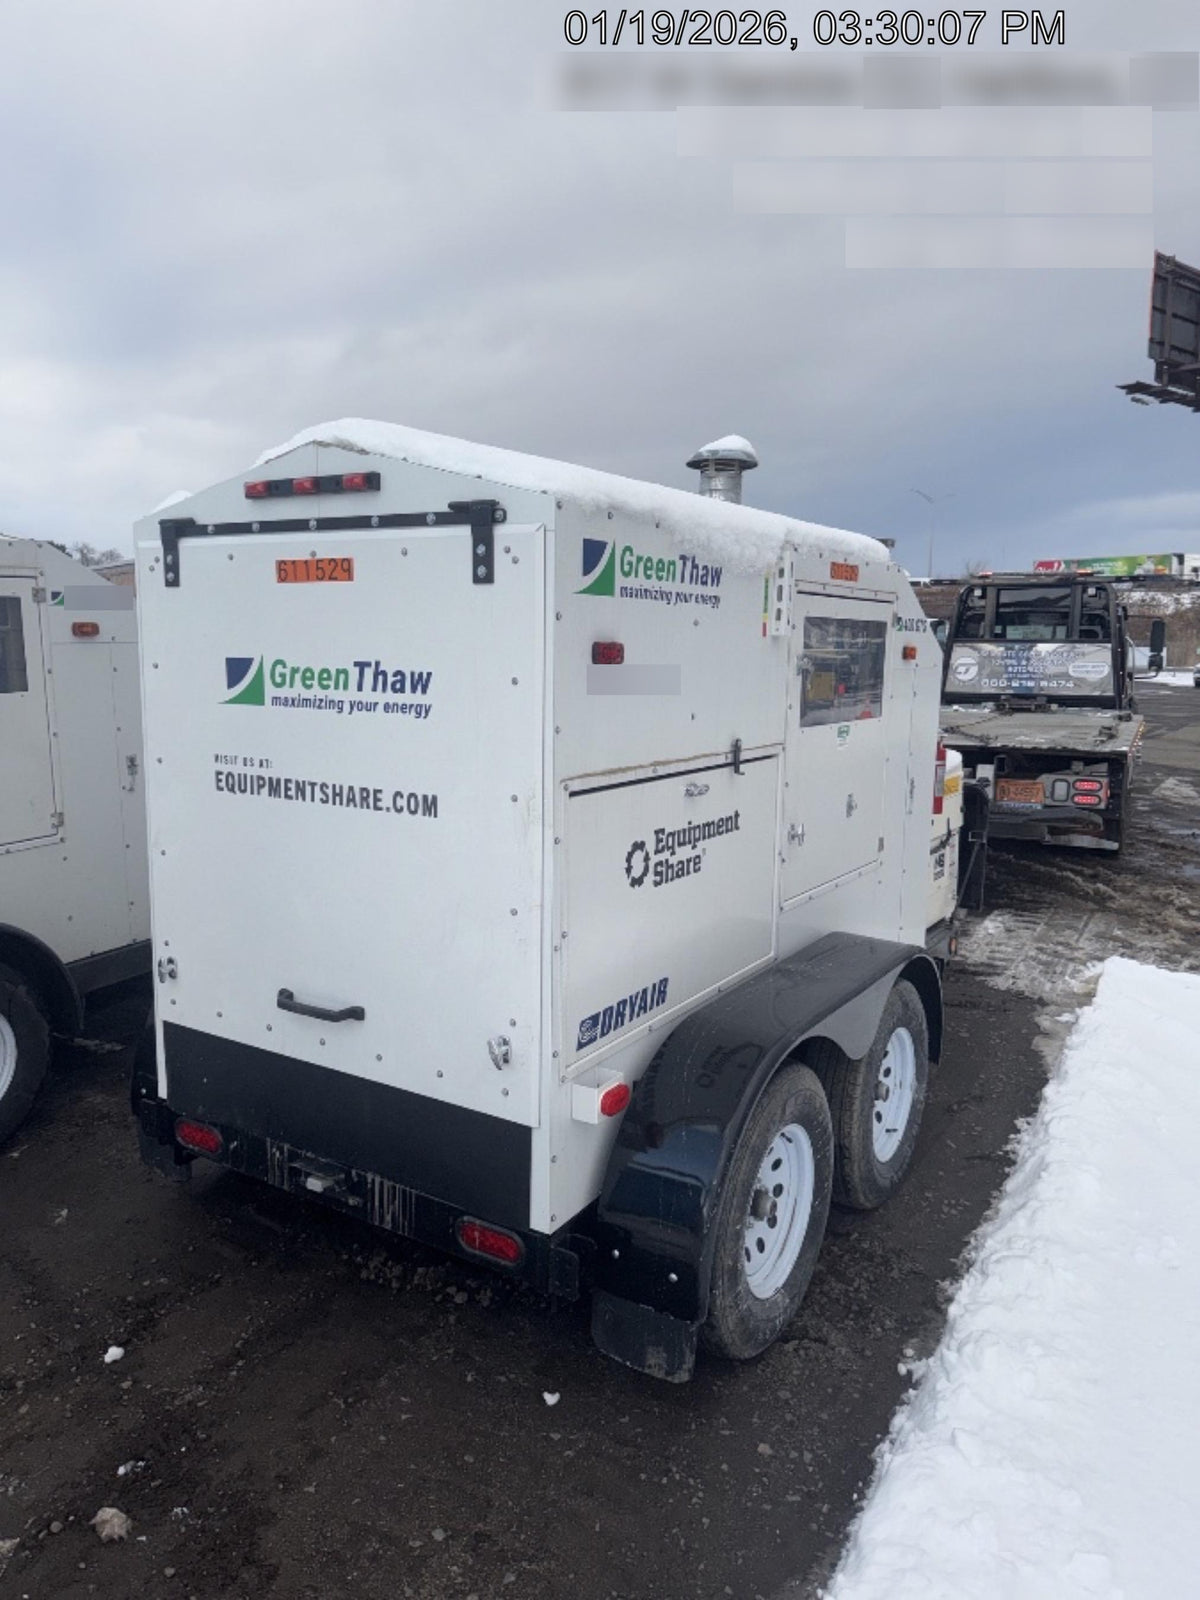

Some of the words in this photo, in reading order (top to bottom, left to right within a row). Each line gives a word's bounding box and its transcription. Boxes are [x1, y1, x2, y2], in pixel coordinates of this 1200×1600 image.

[277, 558, 353, 583] 611529
[620, 545, 723, 588] GreenThaw
[620, 584, 673, 605] maximizing
[673, 591, 693, 606] your
[694, 593, 721, 609] energy
[269, 657, 433, 695] GreenThaw
[271, 693, 344, 713] maximizing
[348, 698, 378, 715] your
[383, 701, 432, 719] energy
[214, 753, 238, 766] VISIT
[243, 757, 255, 768] US
[259, 758, 273, 769] AT:
[215, 770, 439, 819] EQUIPMENTSHARE.COM
[653, 810, 741, 857] Equipment
[653, 854, 702, 888] Share
[598, 977, 669, 1039] DRYAIR
